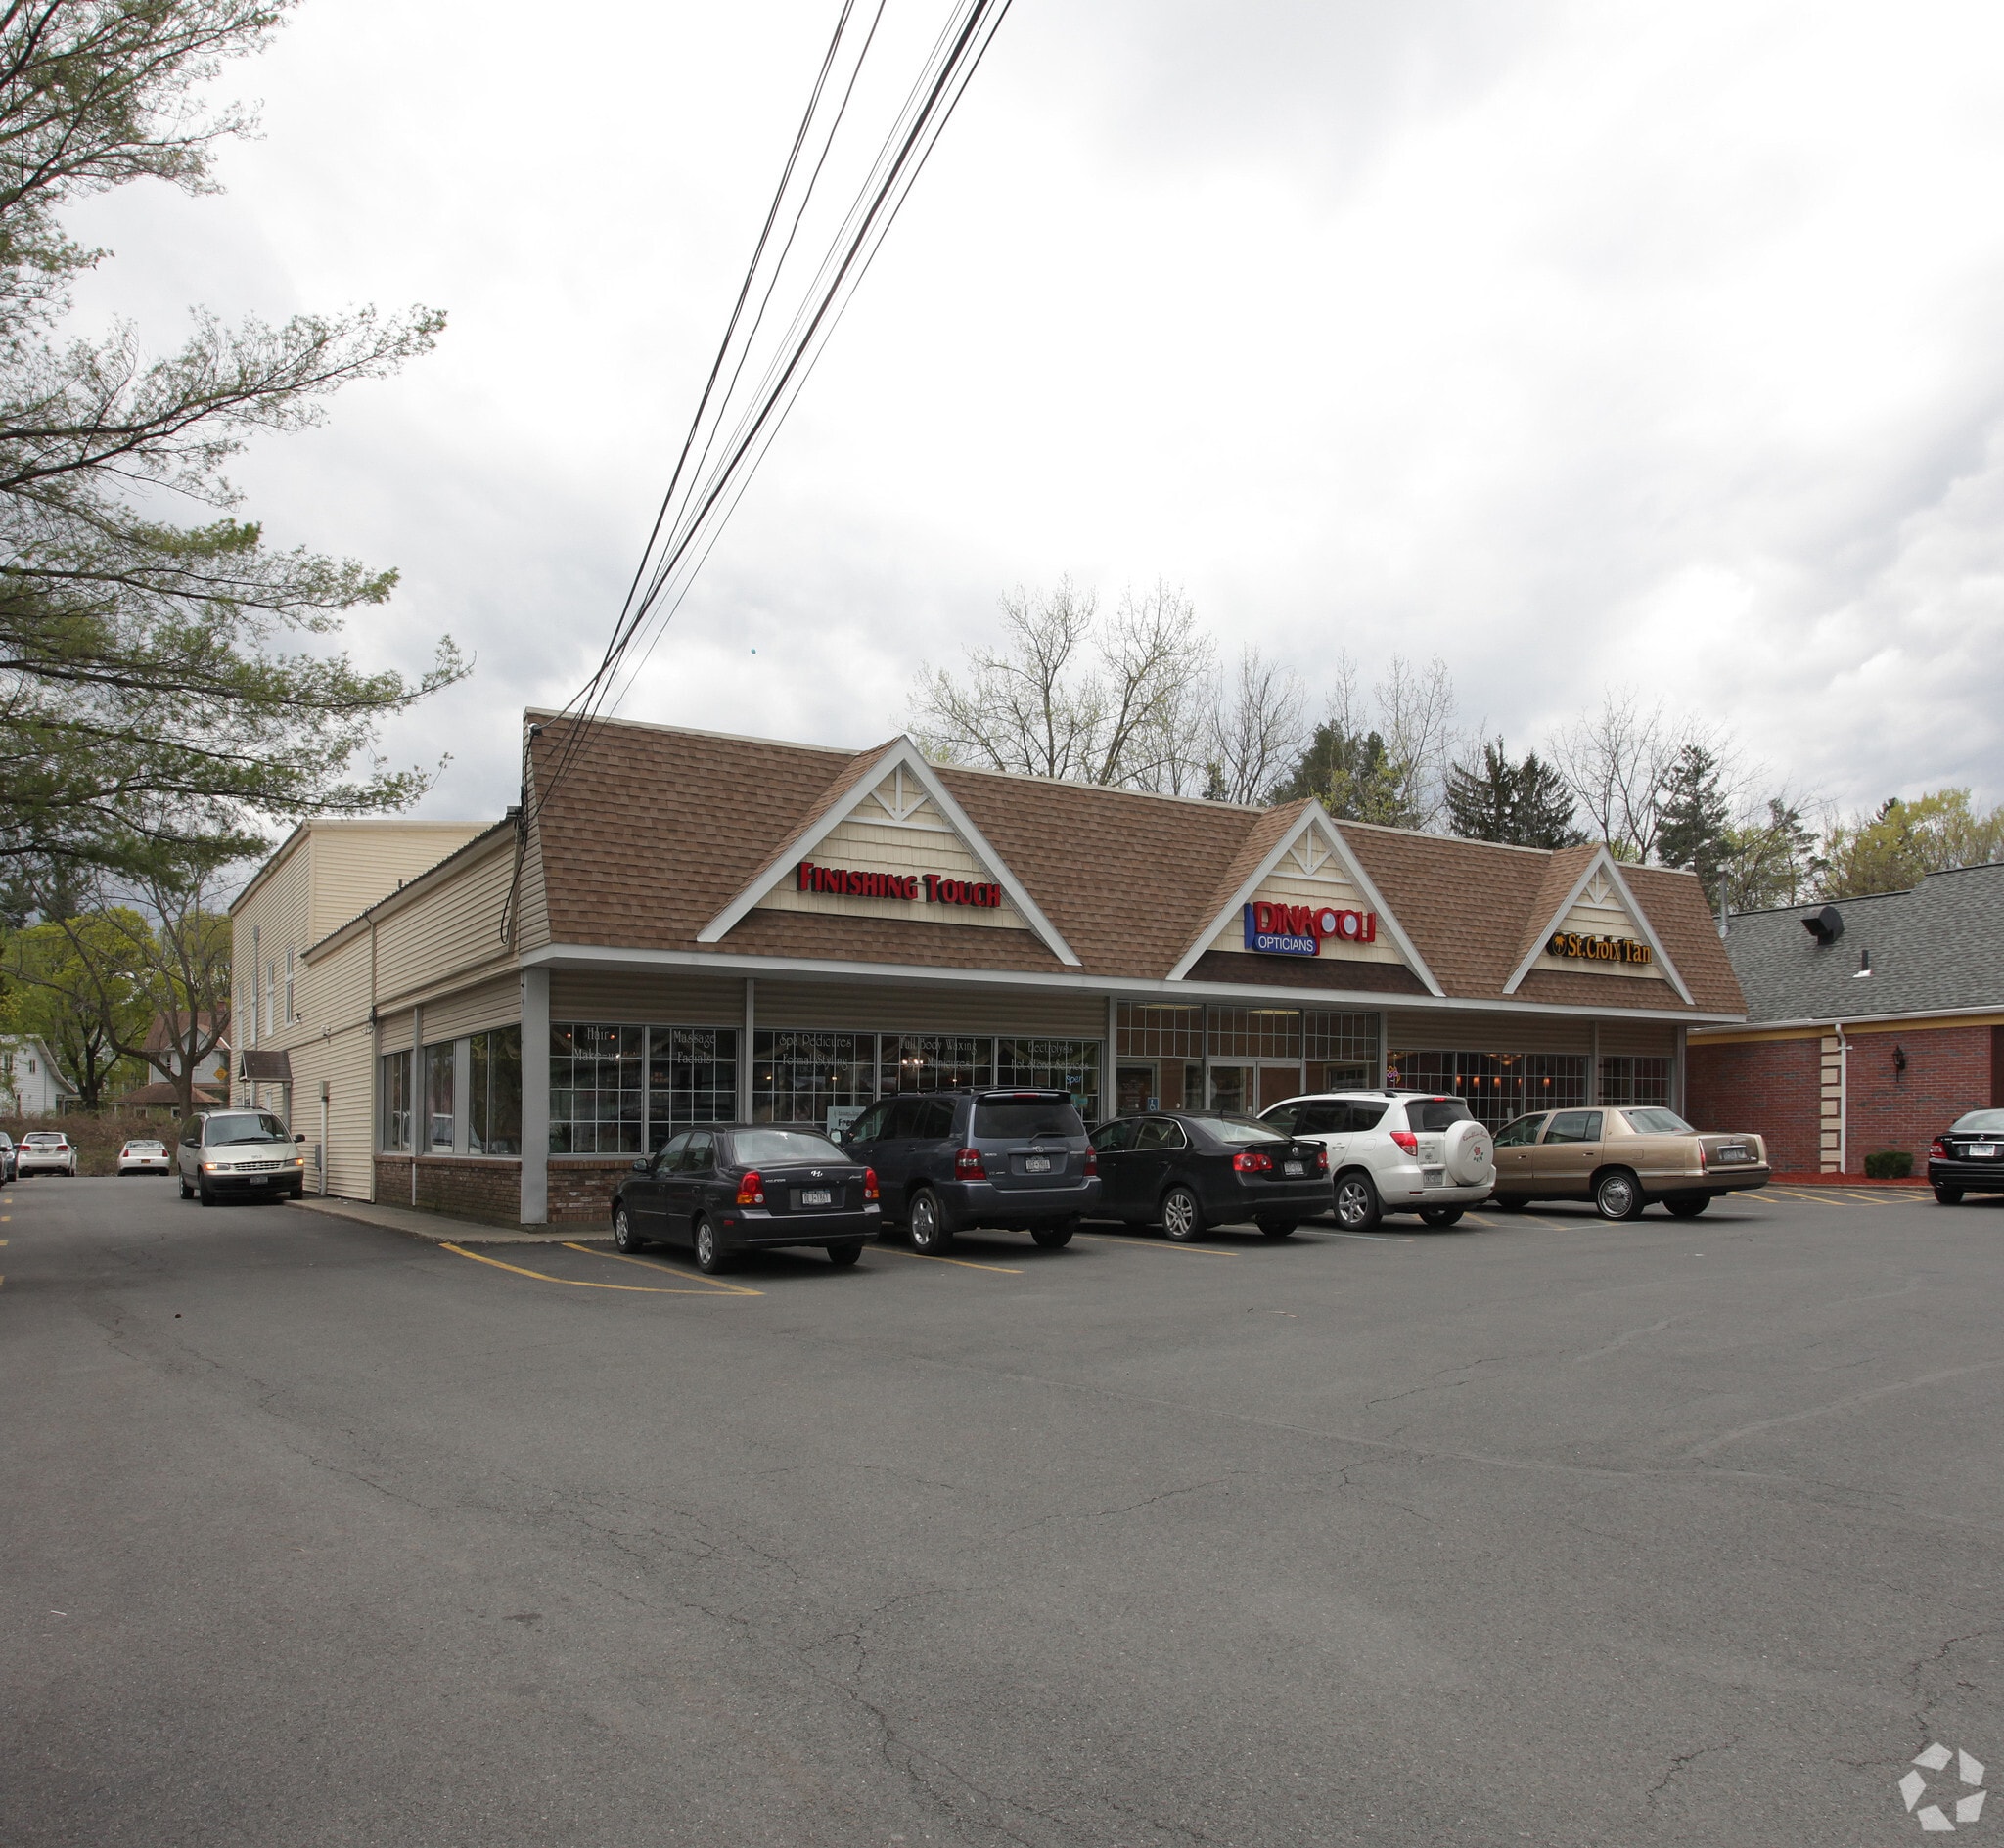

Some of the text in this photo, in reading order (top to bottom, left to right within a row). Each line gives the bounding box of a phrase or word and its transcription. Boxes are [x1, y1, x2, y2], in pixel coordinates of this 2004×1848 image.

[797, 862, 1001, 908] FINISHING TOUCH
[1257, 935, 1314, 953] OPTICIANS
[1586, 935, 1621, 961] Croix
[1624, 940, 1652, 964] Tan
[587, 1027, 610, 1041] Hair
[673, 1030, 716, 1049] Massage
[779, 1034, 852, 1050] Spa Pedicures
[900, 1036, 977, 1056] Full Body Waxing
[677, 1051, 712, 1065] Facials
[783, 1053, 812, 1066] Formal
